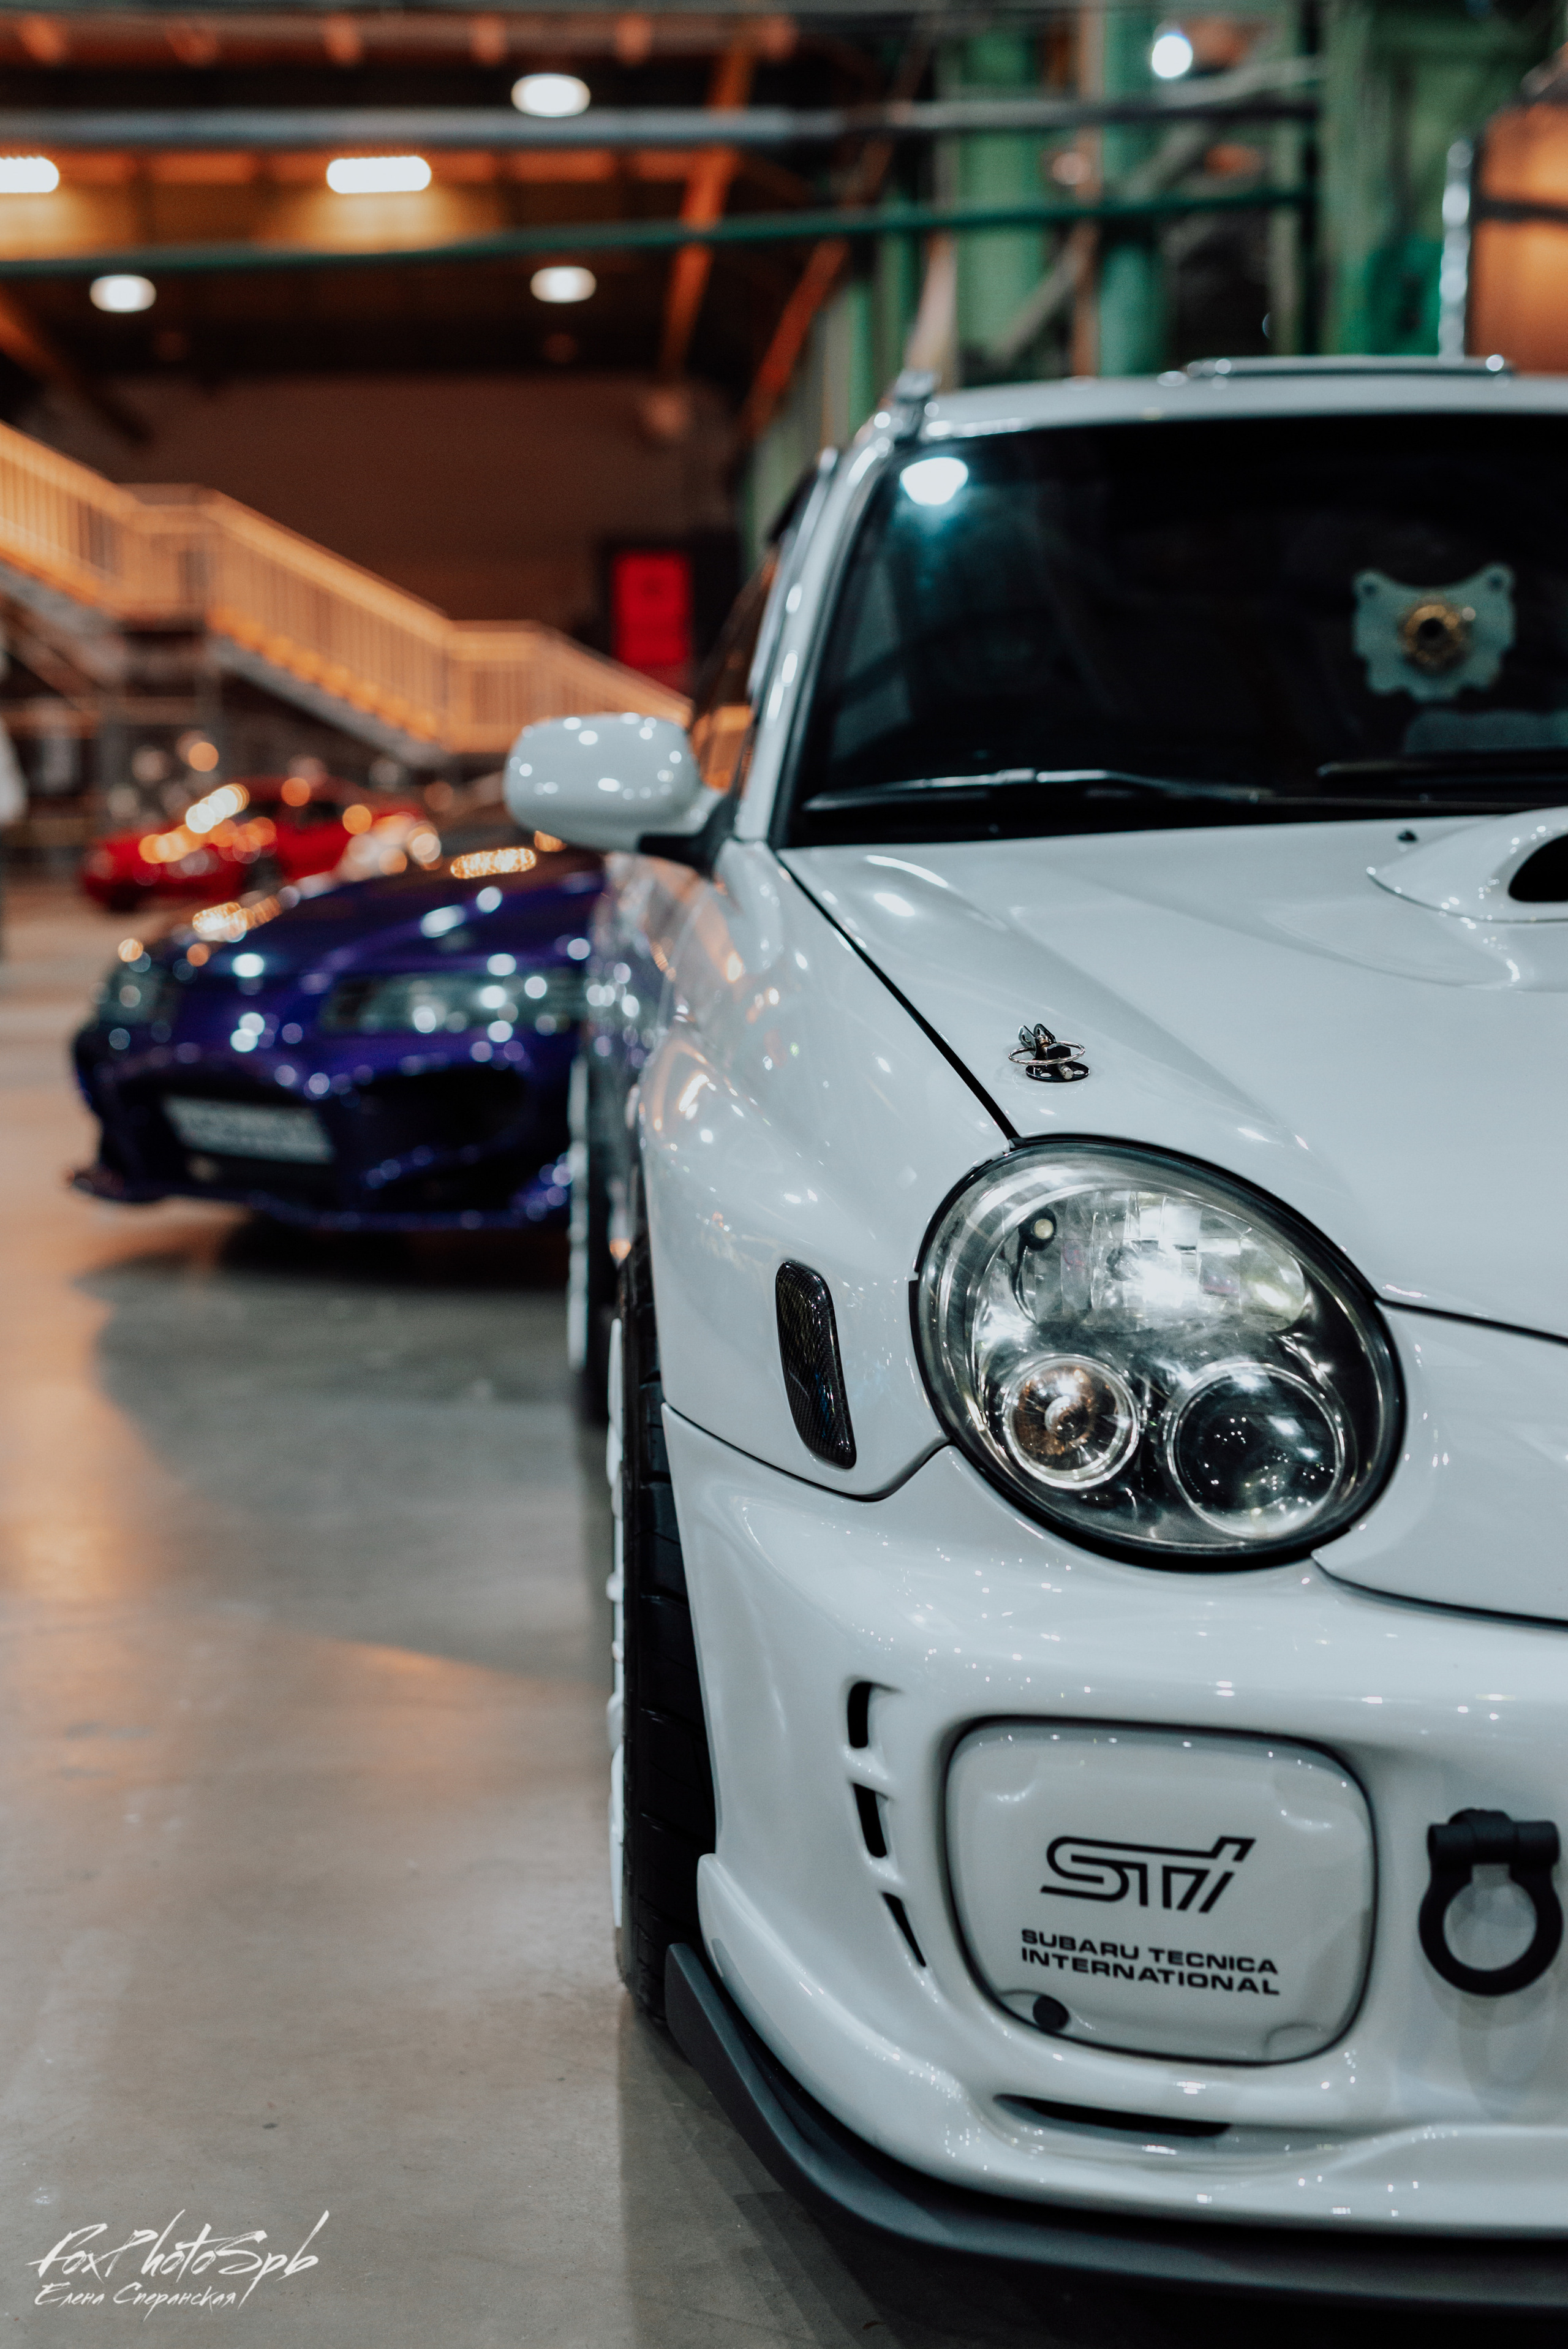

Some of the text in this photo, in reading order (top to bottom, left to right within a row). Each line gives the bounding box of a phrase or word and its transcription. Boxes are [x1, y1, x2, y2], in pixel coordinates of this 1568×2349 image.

[1021, 1929, 1279, 1975] SUBARU TECNICA
[1021, 1947, 1280, 1995] INTERNATIONAL
